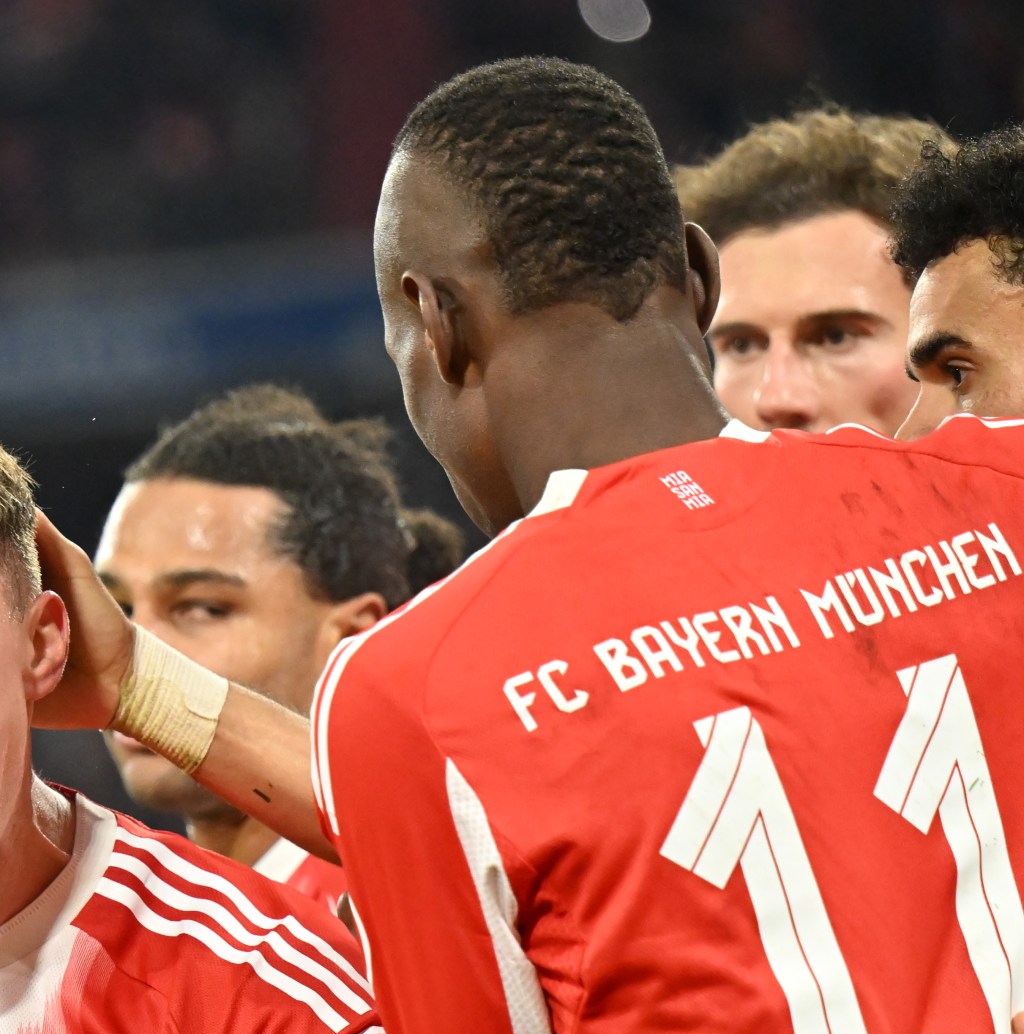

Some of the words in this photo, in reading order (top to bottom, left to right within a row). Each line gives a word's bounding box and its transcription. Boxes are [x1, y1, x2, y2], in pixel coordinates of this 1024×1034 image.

[658, 470, 693, 488] MIA
[669, 481, 704, 499] SAN
[681, 493, 715, 510] MIA
[502, 659, 590, 733] FC
[592, 595, 802, 692] BAYERN
[799, 522, 1023, 639] MÜNCHEN
